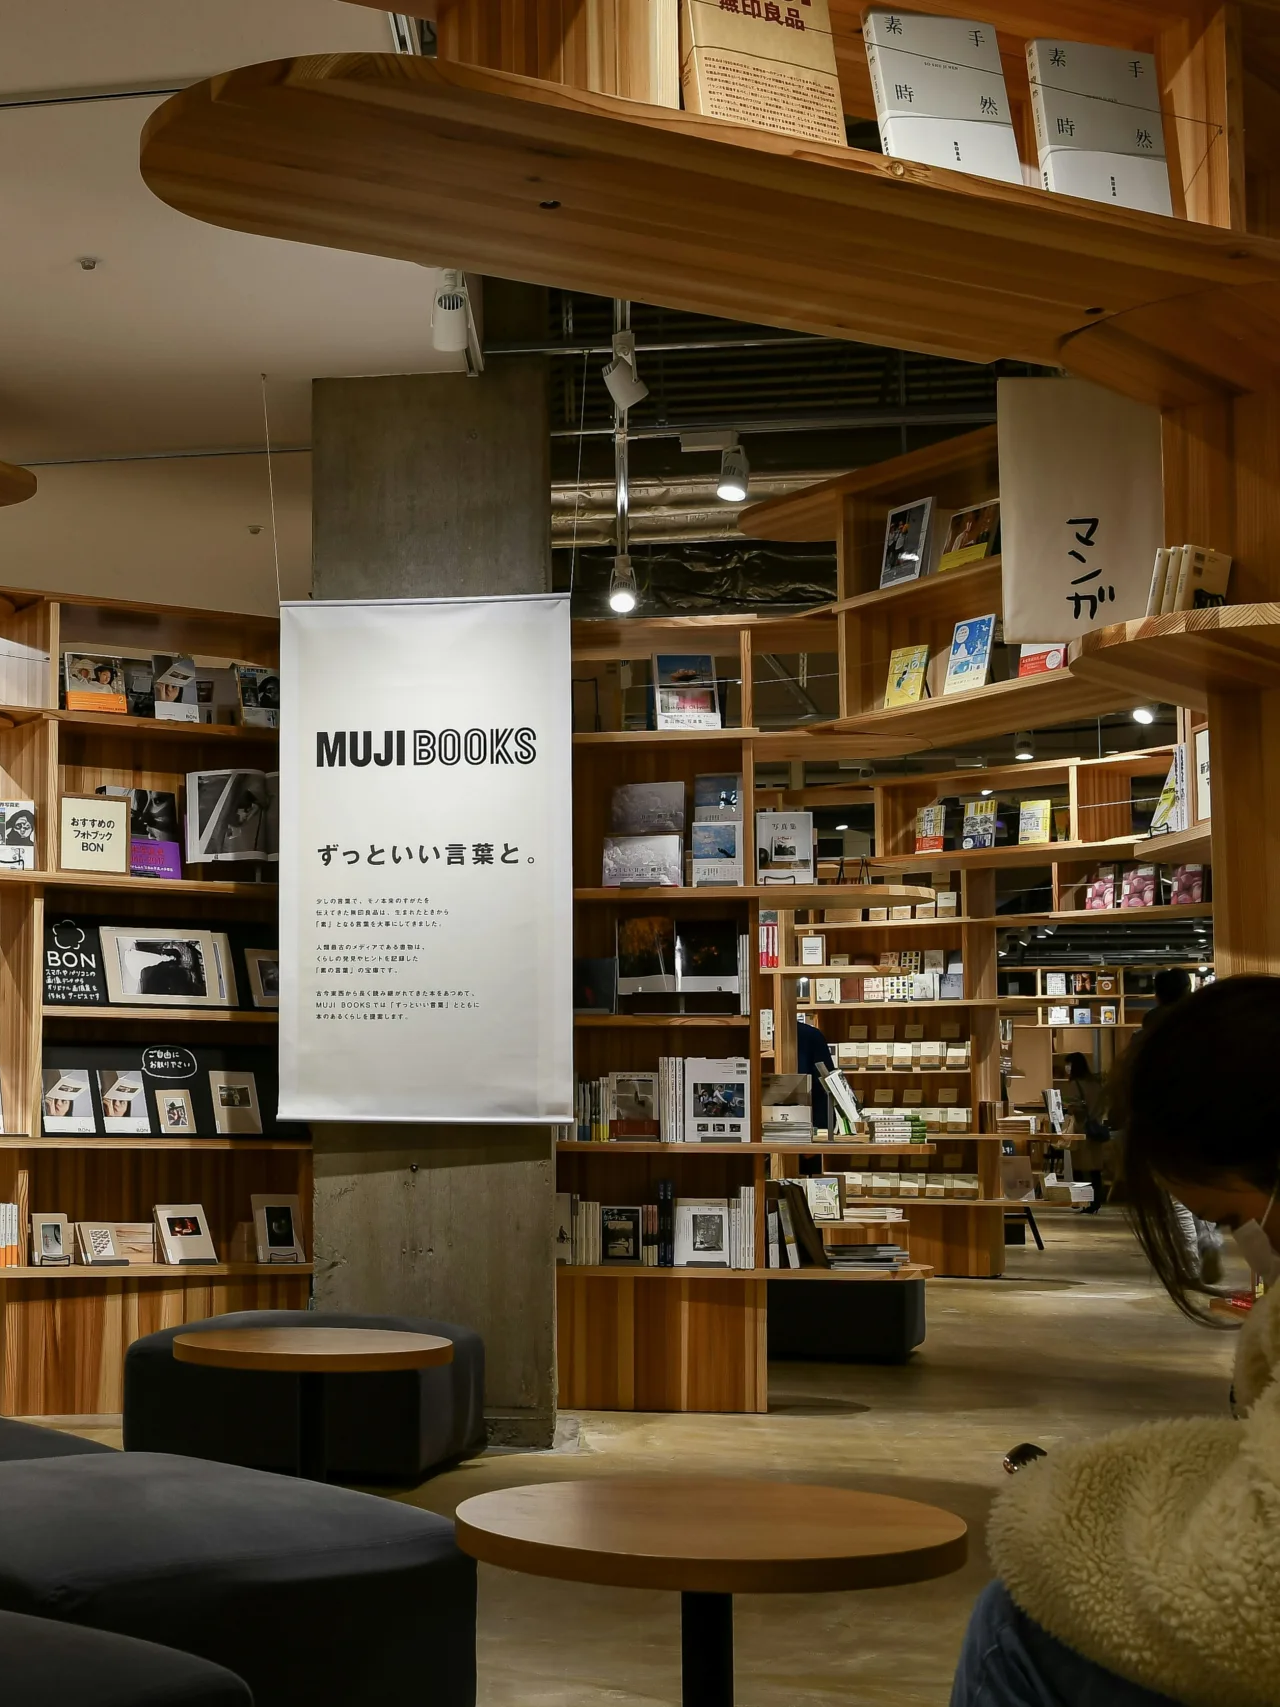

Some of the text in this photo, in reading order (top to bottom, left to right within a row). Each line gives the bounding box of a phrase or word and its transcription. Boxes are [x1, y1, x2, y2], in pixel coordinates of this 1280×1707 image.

[884, 17, 986, 48] 素 手
[1048, 47, 1145, 78] 素 手
[895, 83, 915, 103] 時
[980, 95, 999, 116] 然
[1056, 117, 1153, 149] 時 然
[1066, 517, 1116, 620] マンガ
[317, 726, 537, 768] MUJI BOOKS
[70, 817, 115, 829] おすすめの
[73, 829, 113, 841] フォトブック
[81, 842, 104, 853] BON
[317, 842, 535, 868] ずっといい言葉と。
[46, 950, 97, 969] BON
[315, 1001, 337, 1009] MUJI
